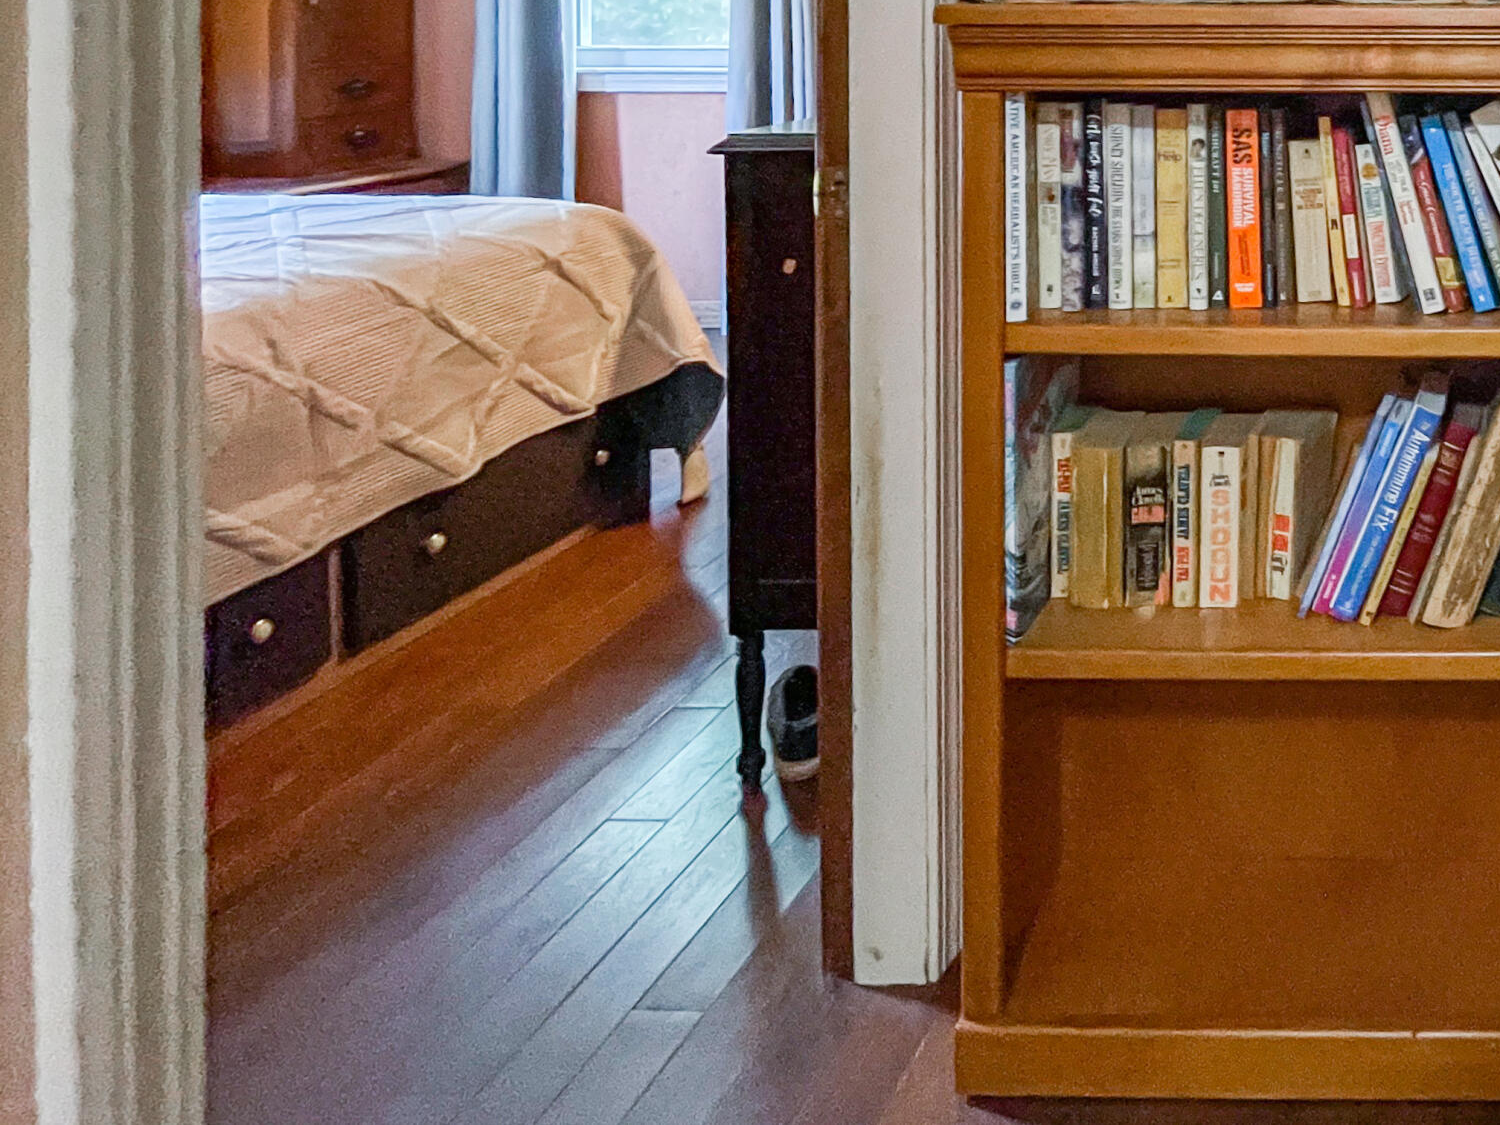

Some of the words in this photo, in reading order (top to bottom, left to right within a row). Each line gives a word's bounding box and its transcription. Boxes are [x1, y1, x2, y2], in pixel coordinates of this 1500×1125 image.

[1232, 128, 1252, 164] SAS
[1375, 113, 1395, 156] Diana
[1009, 133, 1020, 188] AMERICAN
[1110, 161, 1124, 202] SHELDON
[1231, 167, 1243, 227] HANDBOOK
[1241, 167, 1254, 226] SURVIVAL
[1010, 191, 1020, 259] HERBALIST'S
[1010, 263, 1020, 293] BIBLE
[1383, 428, 1430, 504] Autoimmune
[1371, 505, 1398, 532] Fix
